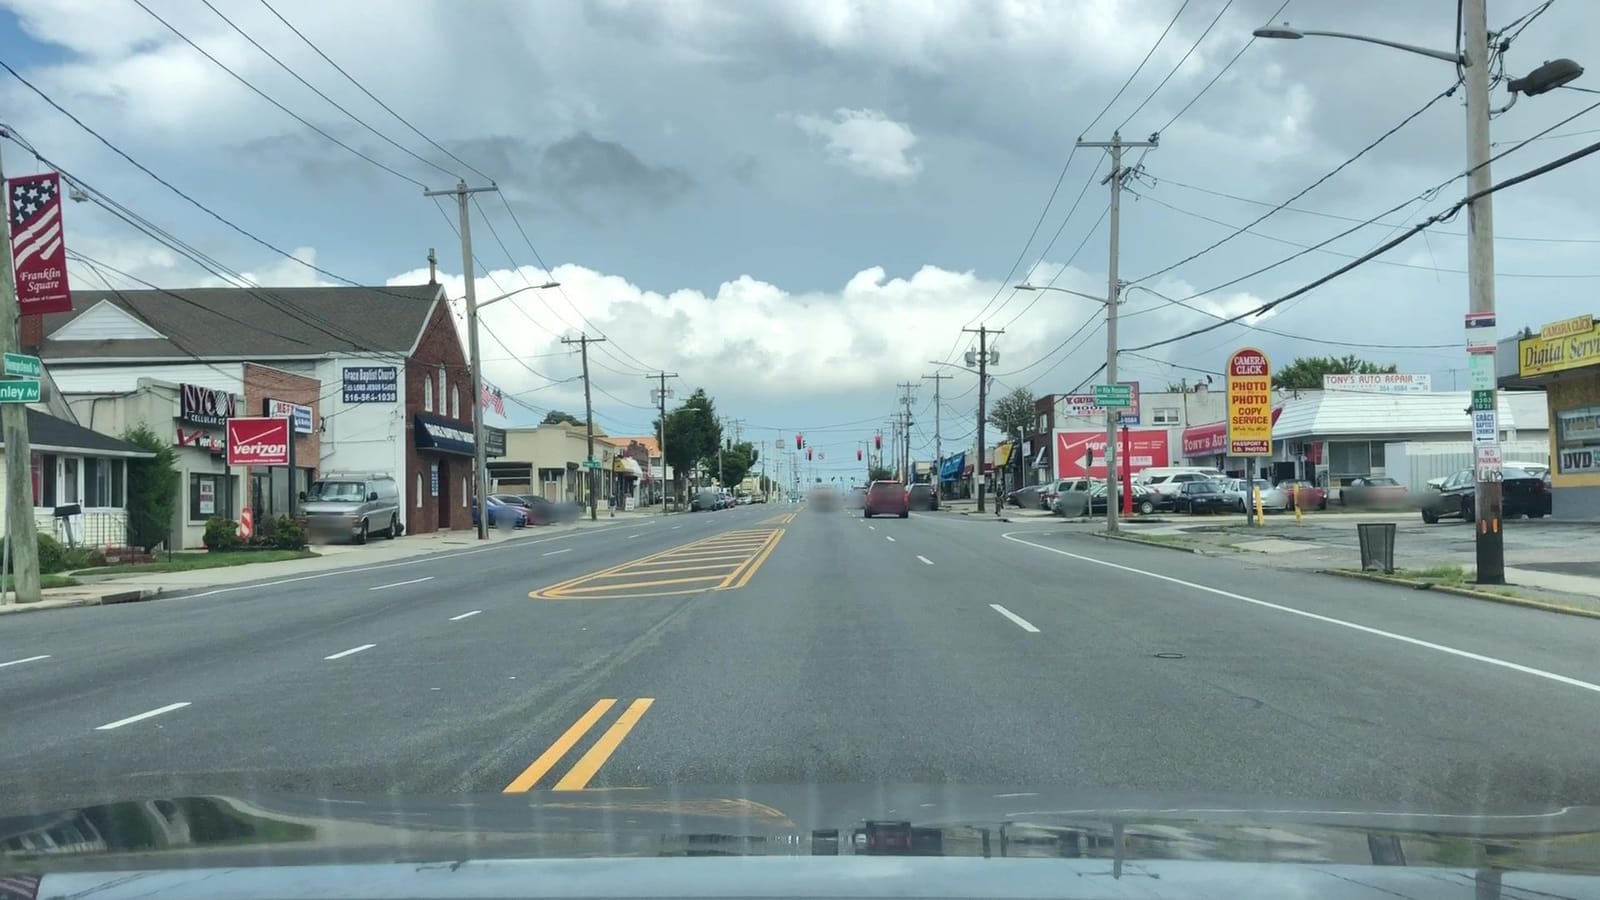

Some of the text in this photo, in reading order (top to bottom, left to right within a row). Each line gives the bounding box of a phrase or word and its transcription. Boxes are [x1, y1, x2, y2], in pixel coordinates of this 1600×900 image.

[20, 267, 61, 281] Franklin
[27, 281, 60, 293] Square
[1234, 356, 1266, 366] CAMERA
[1524, 341, 1565, 371] Digital
[360, 368, 377, 384] Baptist
[378, 367, 396, 380] Church
[1326, 376, 1355, 385] TONY'S
[1359, 375, 1381, 384] AUTO
[1384, 375, 1413, 384] REPAIR
[1232, 382, 1267, 391] PHOTO
[26, 388, 38, 397] Av
[1232, 395, 1267, 404] PHOTO
[1238, 407, 1262, 416] COPY
[191, 414, 217, 424] CELLULAR
[1232, 416, 1268, 425] SERVICE
[1476, 413, 1494, 421] GRACE
[233, 442, 286, 456] verizon
[1484, 449, 1494, 457] NO
[1563, 451, 1593, 470] DVD
